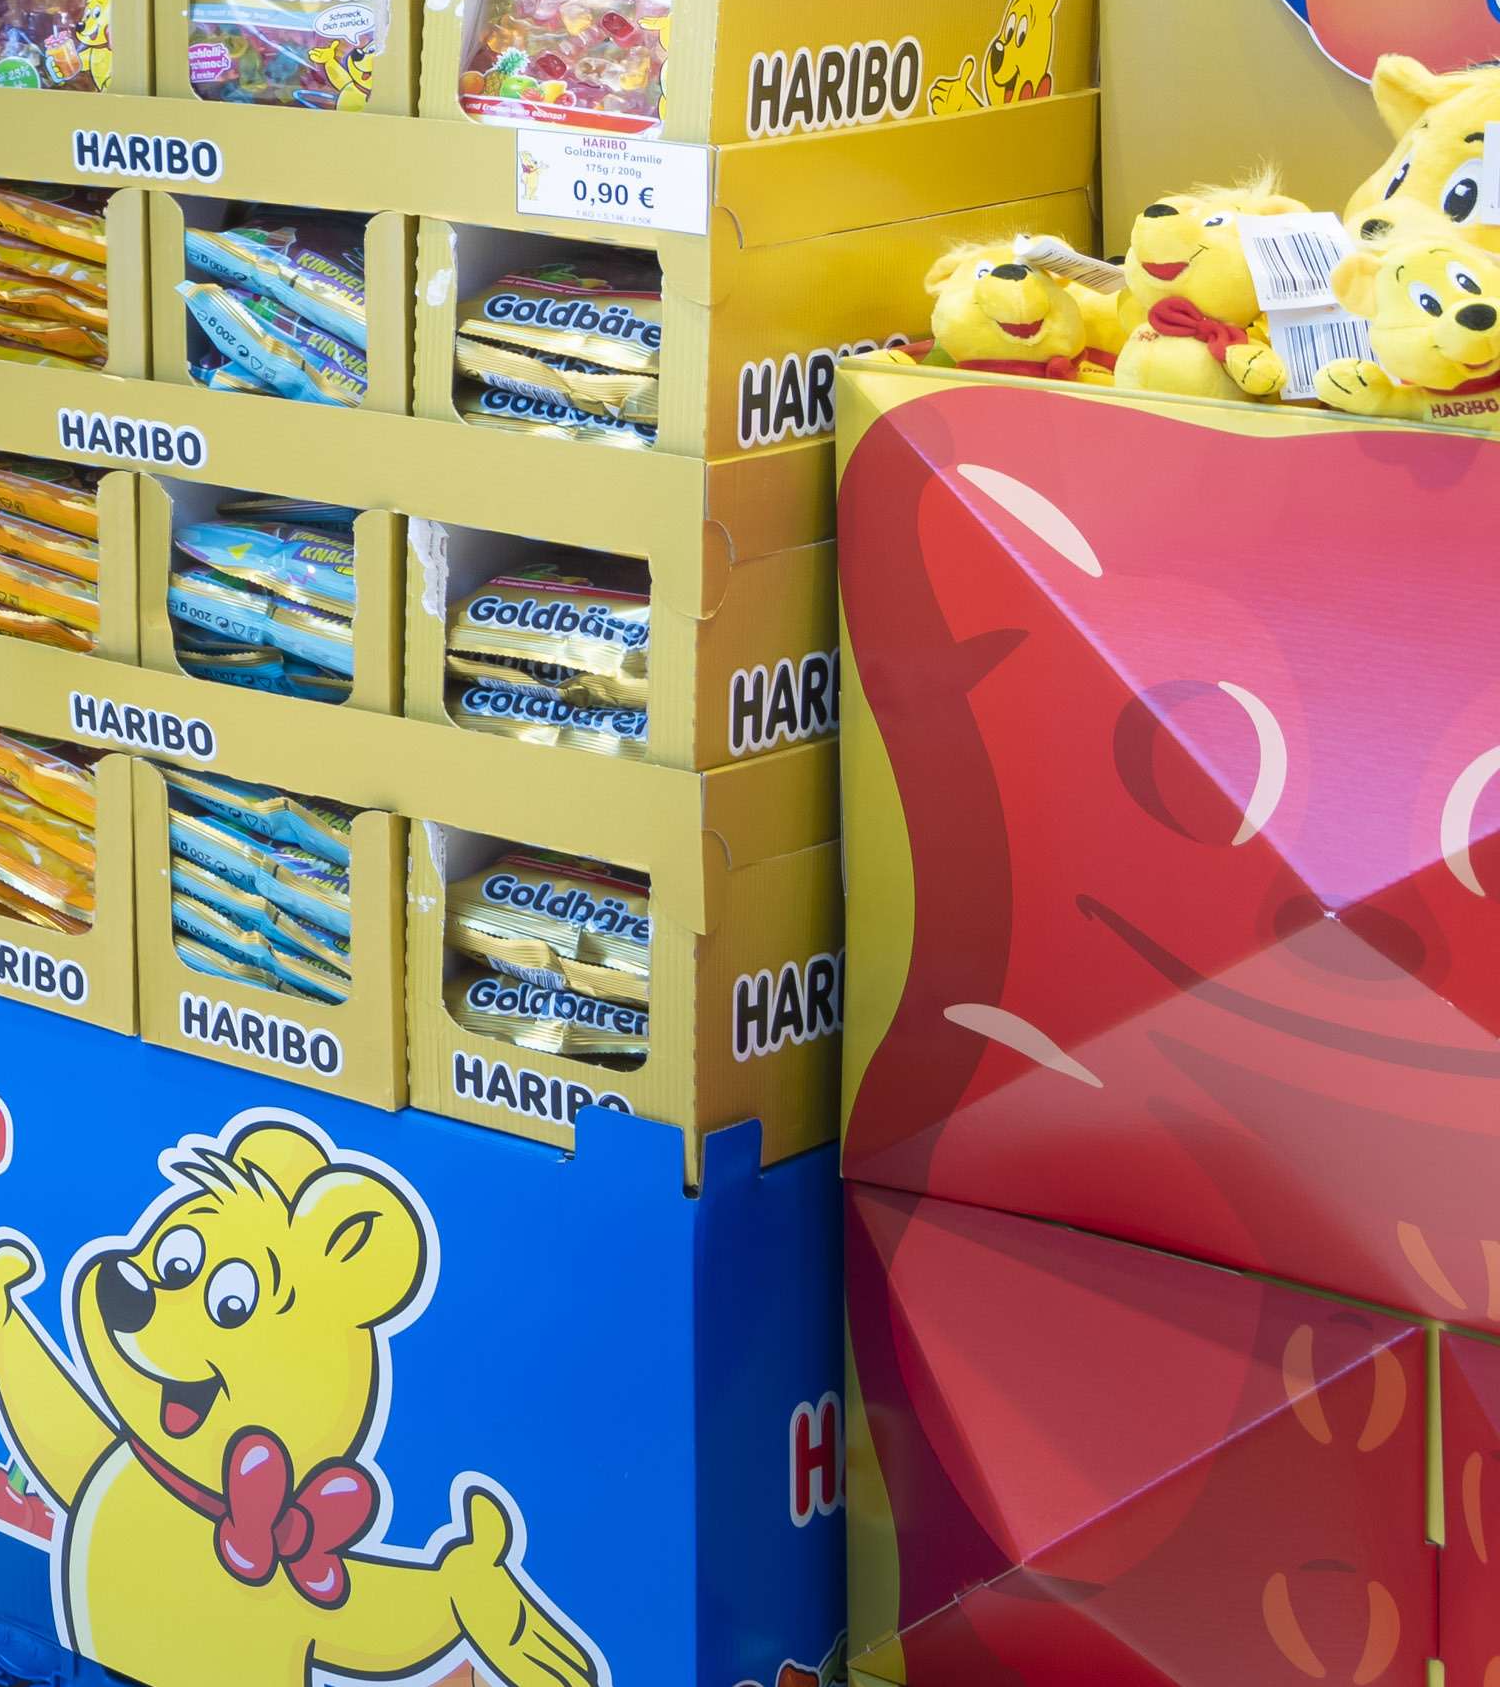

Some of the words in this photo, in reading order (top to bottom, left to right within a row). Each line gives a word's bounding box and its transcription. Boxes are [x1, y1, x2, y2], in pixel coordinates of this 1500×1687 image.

[322, 21, 338, 31] Dich
[339, 18, 370, 29] zurück!
[328, 10, 361, 20] Schmeck
[747, 38, 922, 137] HARIBO
[74, 133, 221, 180] HARIBO
[564, 146, 620, 161] Goldbären
[623, 153, 662, 165] Familie
[583, 137, 627, 151] HARIBO
[586, 164, 609, 175] 175g
[618, 167, 642, 179] 200g
[574, 179, 628, 207] 0,90
[638, 187, 654, 208] €
[486, 294, 661, 348] Goldbäre
[1429, 397, 1500, 419] HARIBO
[60, 410, 206, 468] HARIBO
[69, 691, 216, 759] HARIBO
[485, 873, 650, 942] Goldbäre
[180, 993, 343, 1074] HARIBO
